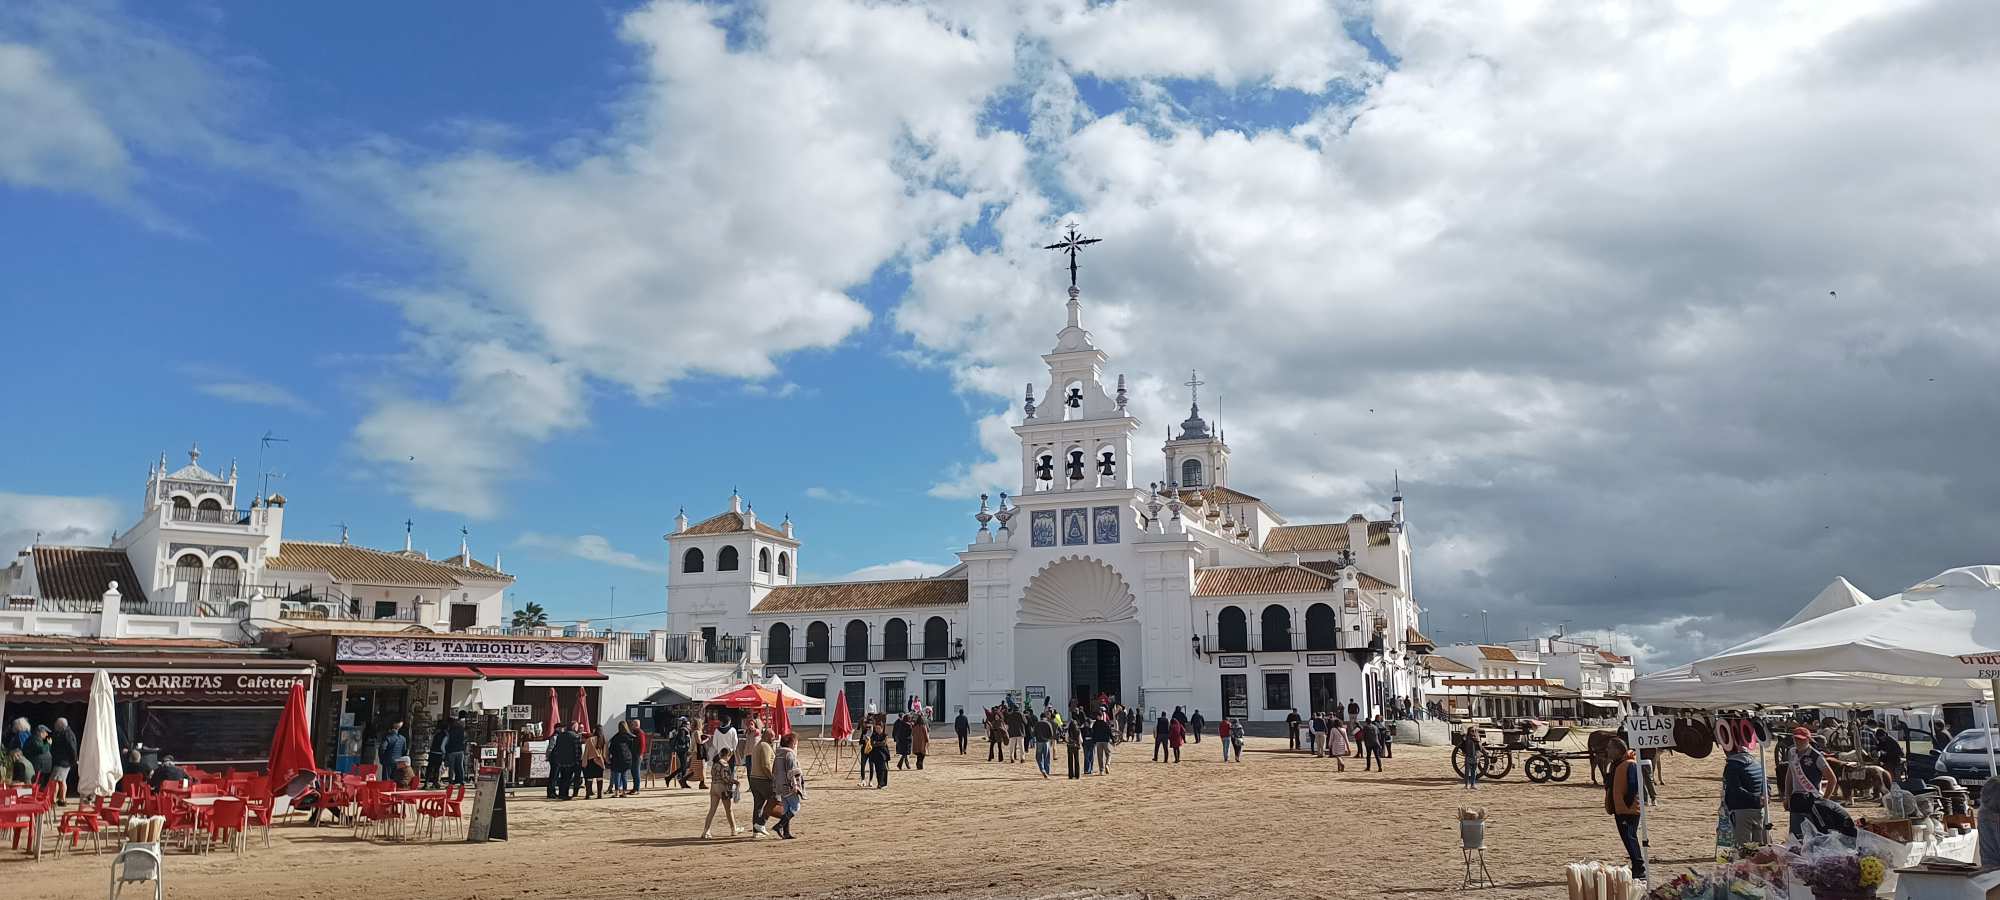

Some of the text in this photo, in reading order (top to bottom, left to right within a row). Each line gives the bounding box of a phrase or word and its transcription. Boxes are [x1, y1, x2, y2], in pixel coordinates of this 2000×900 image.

[413, 641, 530, 655] EL TAMBORIL
[110, 675, 131, 688] AS
[135, 675, 222, 688] CARRETAS
[510, 705, 528, 713] VELAS
[1630, 718, 1672, 731] VELAS
[1638, 735, 1669, 746] 0.75 €
